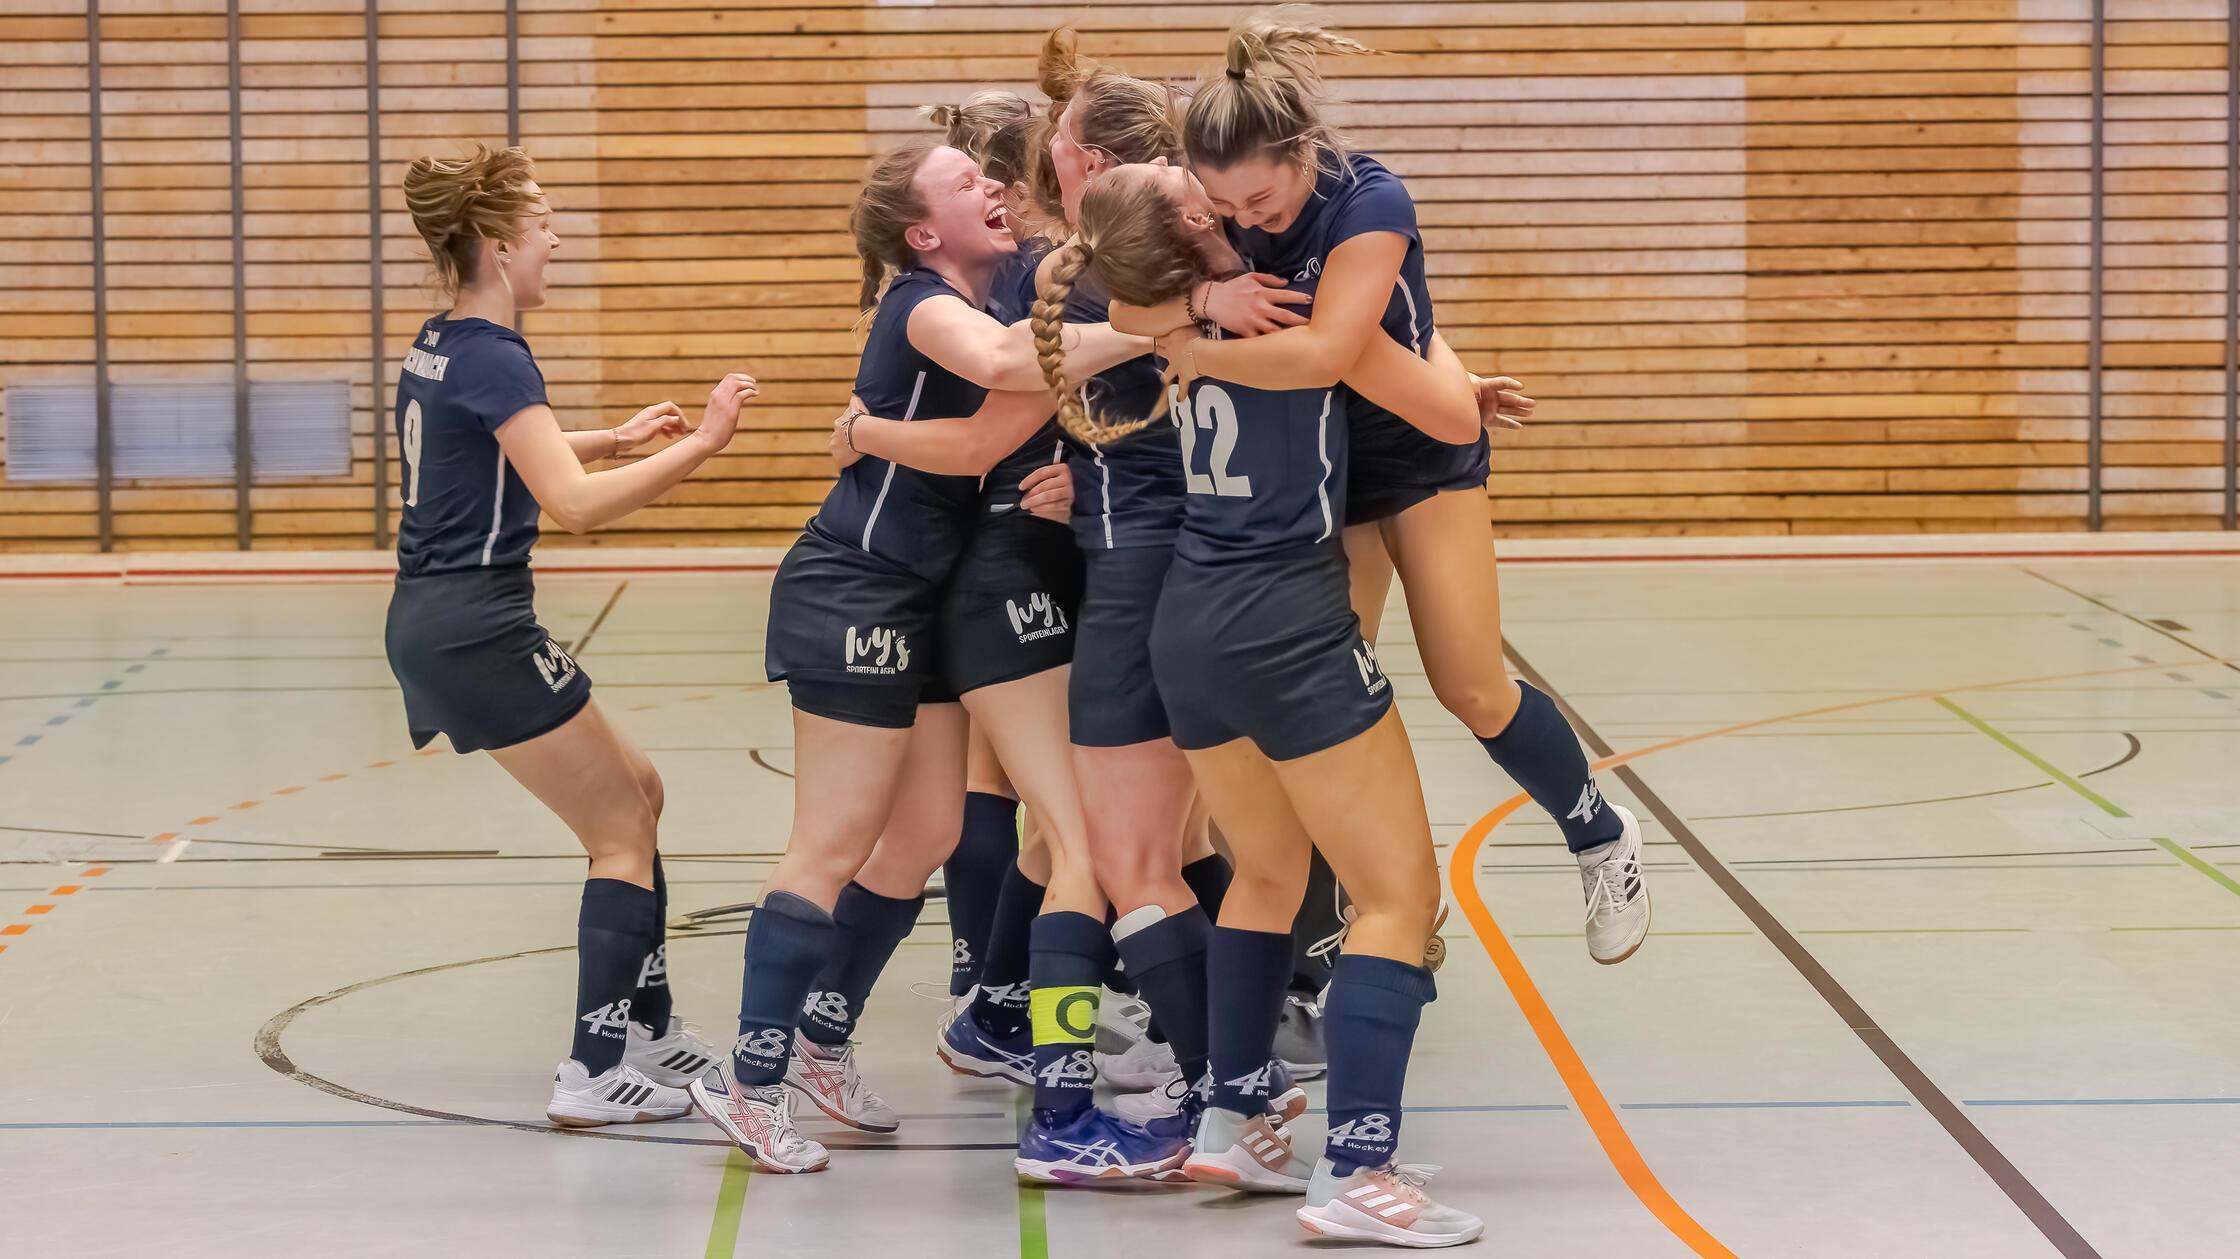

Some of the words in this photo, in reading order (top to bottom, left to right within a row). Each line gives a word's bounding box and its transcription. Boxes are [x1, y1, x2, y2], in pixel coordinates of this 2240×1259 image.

[403, 398, 423, 508] 9
[1168, 384, 1252, 497] 22
[845, 626, 911, 671] Ivy's
[581, 998, 632, 1035] 48
[803, 991, 849, 1022] 48
[1056, 991, 1100, 1039] C
[602, 1030, 626, 1041] Hockey
[812, 1014, 847, 1034] Hockey
[734, 1028, 788, 1058] 48
[741, 1054, 777, 1070] Hockey
[1039, 1050, 1096, 1088] 48
[1060, 1081, 1093, 1090] Hockey
[1327, 1113, 1392, 1147] 48
[1347, 1142, 1389, 1154] Hockey
